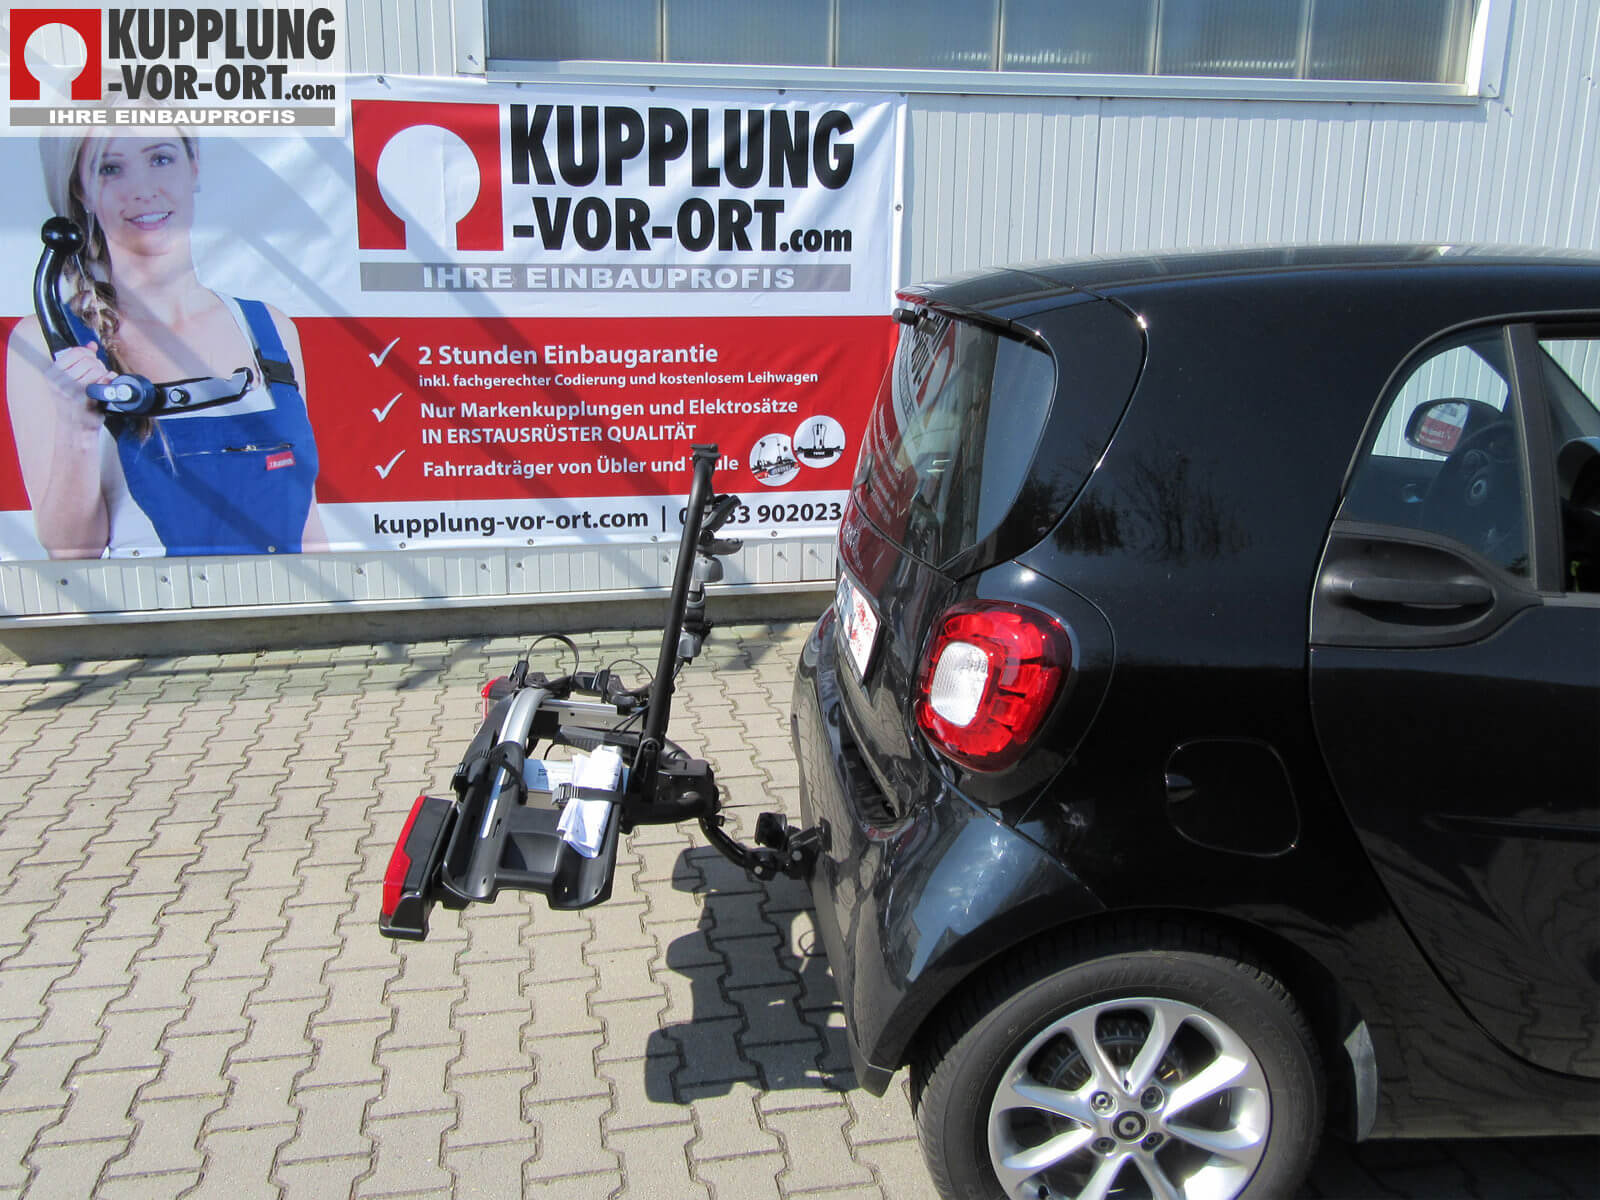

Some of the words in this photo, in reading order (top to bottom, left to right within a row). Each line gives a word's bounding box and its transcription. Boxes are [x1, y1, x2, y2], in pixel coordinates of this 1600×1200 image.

[510, 103, 855, 189] KUPPLUNG
[512, 196, 852, 252] -VOR-ORT.com
[423, 266, 513, 289] IHRE
[526, 266, 795, 289] EINBAUPROFIS
[418, 346, 433, 365] 2
[438, 344, 538, 365] Stunden
[544, 343, 719, 369] Einbaugarantie
[418, 374, 450, 387] inkl.
[452, 373, 552, 390] fachgerechter
[554, 372, 626, 388] Codierung
[629, 371, 657, 386] und
[659, 371, 745, 385] kostenlosem
[747, 370, 819, 386] Leihwagen
[420, 402, 456, 418] Nur
[460, 400, 645, 421] Markenkupplungen
[649, 398, 685, 416] und
[689, 397, 798, 415] Elektrosätze
[422, 428, 442, 444] IN
[447, 423, 603, 444] ERSTAUSRÜSTER
[607, 421, 697, 443] QUALITÄT
[423, 459, 554, 479] Fahrradträger
[558, 461, 592, 475] von
[596, 455, 647, 474] Übler
[651, 456, 686, 473] und
[689, 454, 740, 472] ule
[373, 511, 649, 539] kupplung-vor-ort.com
[757, 502, 843, 524] 902023
